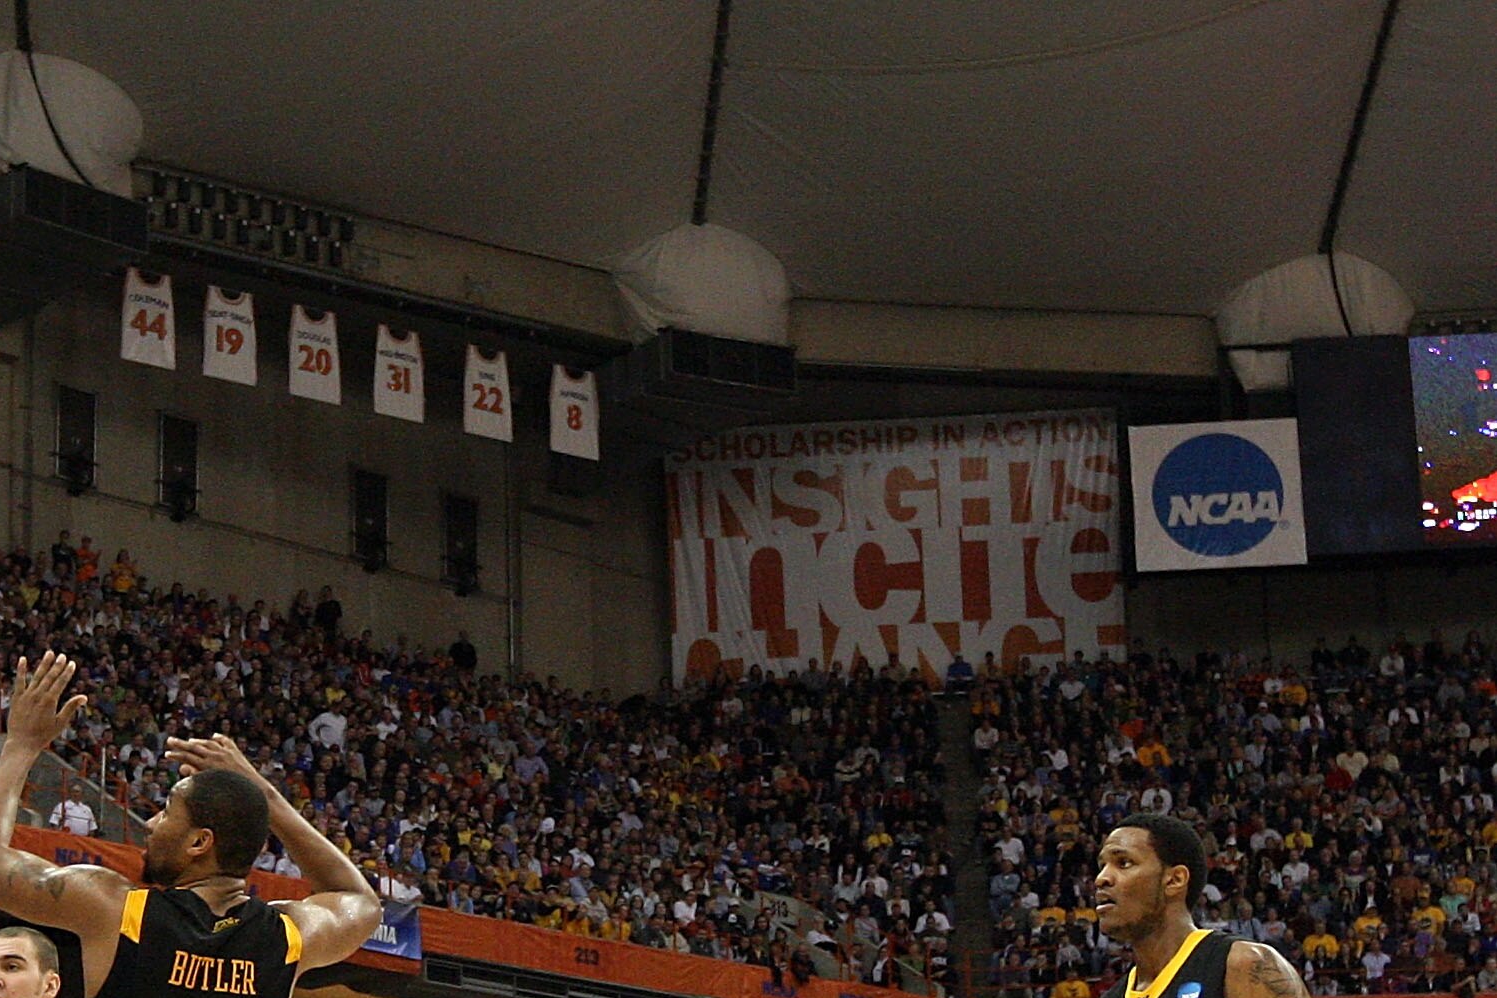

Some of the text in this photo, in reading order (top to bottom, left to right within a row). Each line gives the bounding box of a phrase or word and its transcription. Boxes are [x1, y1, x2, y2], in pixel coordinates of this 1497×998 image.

[130, 308, 167, 341] 44
[216, 324, 244, 355] 19
[297, 344, 332, 376] 20
[386, 363, 411, 394] 31
[471, 382, 503, 415] 22
[566, 404, 582, 431] 8
[672, 415, 1109, 464] SCHOLARSHIP IN ACTION
[1167, 490, 1279, 527] NCAA
[168, 950, 256, 995] BUTLER
